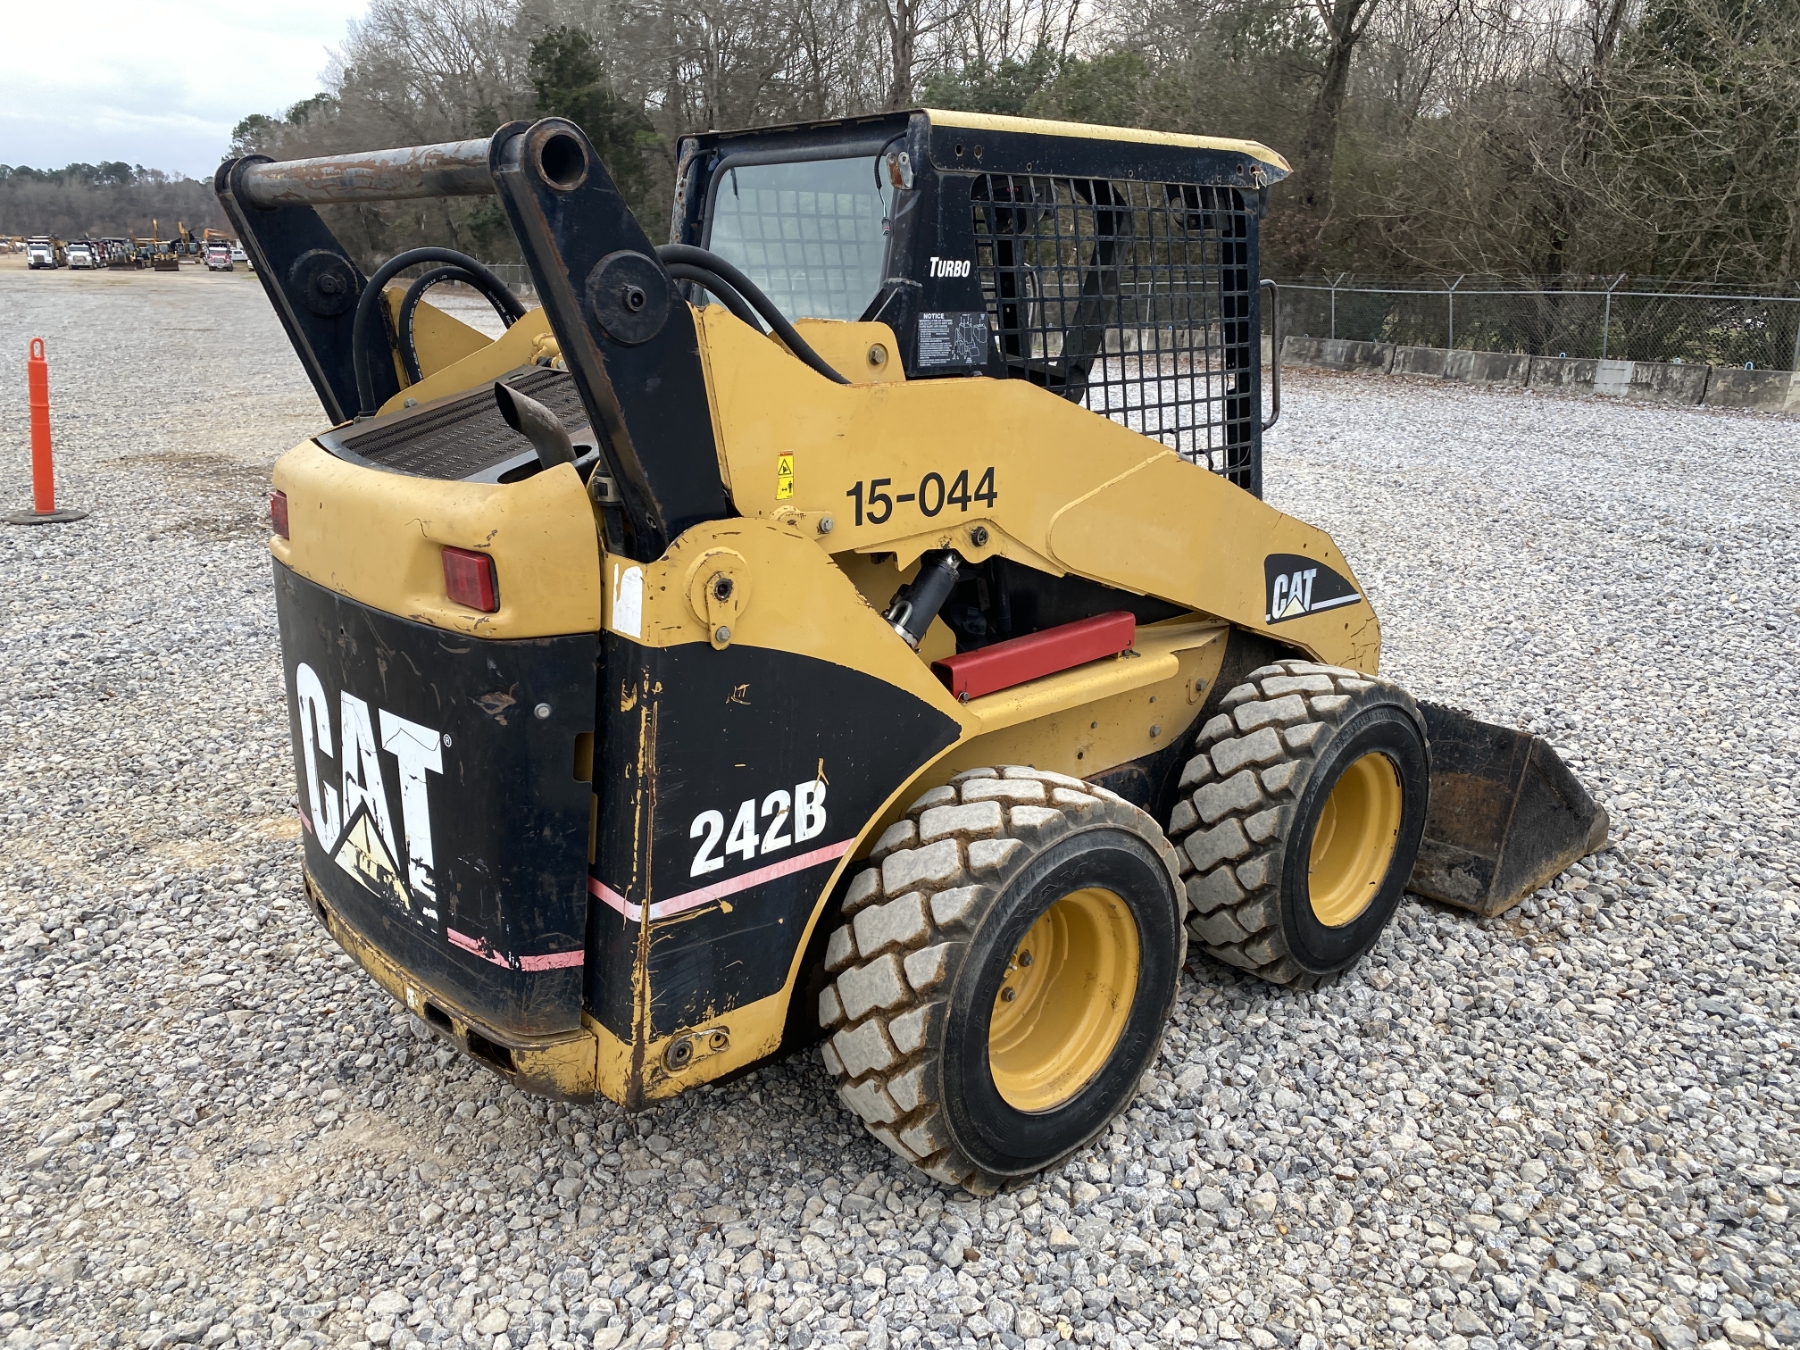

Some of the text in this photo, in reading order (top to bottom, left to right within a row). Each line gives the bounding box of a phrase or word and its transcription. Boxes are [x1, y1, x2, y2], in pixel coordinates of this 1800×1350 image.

[923, 312, 945, 320] NOTICE
[846, 466, 998, 527] 15-044
[1271, 568, 1317, 620] CAT
[296, 662, 444, 930] CAT
[689, 780, 827, 878] 242B
